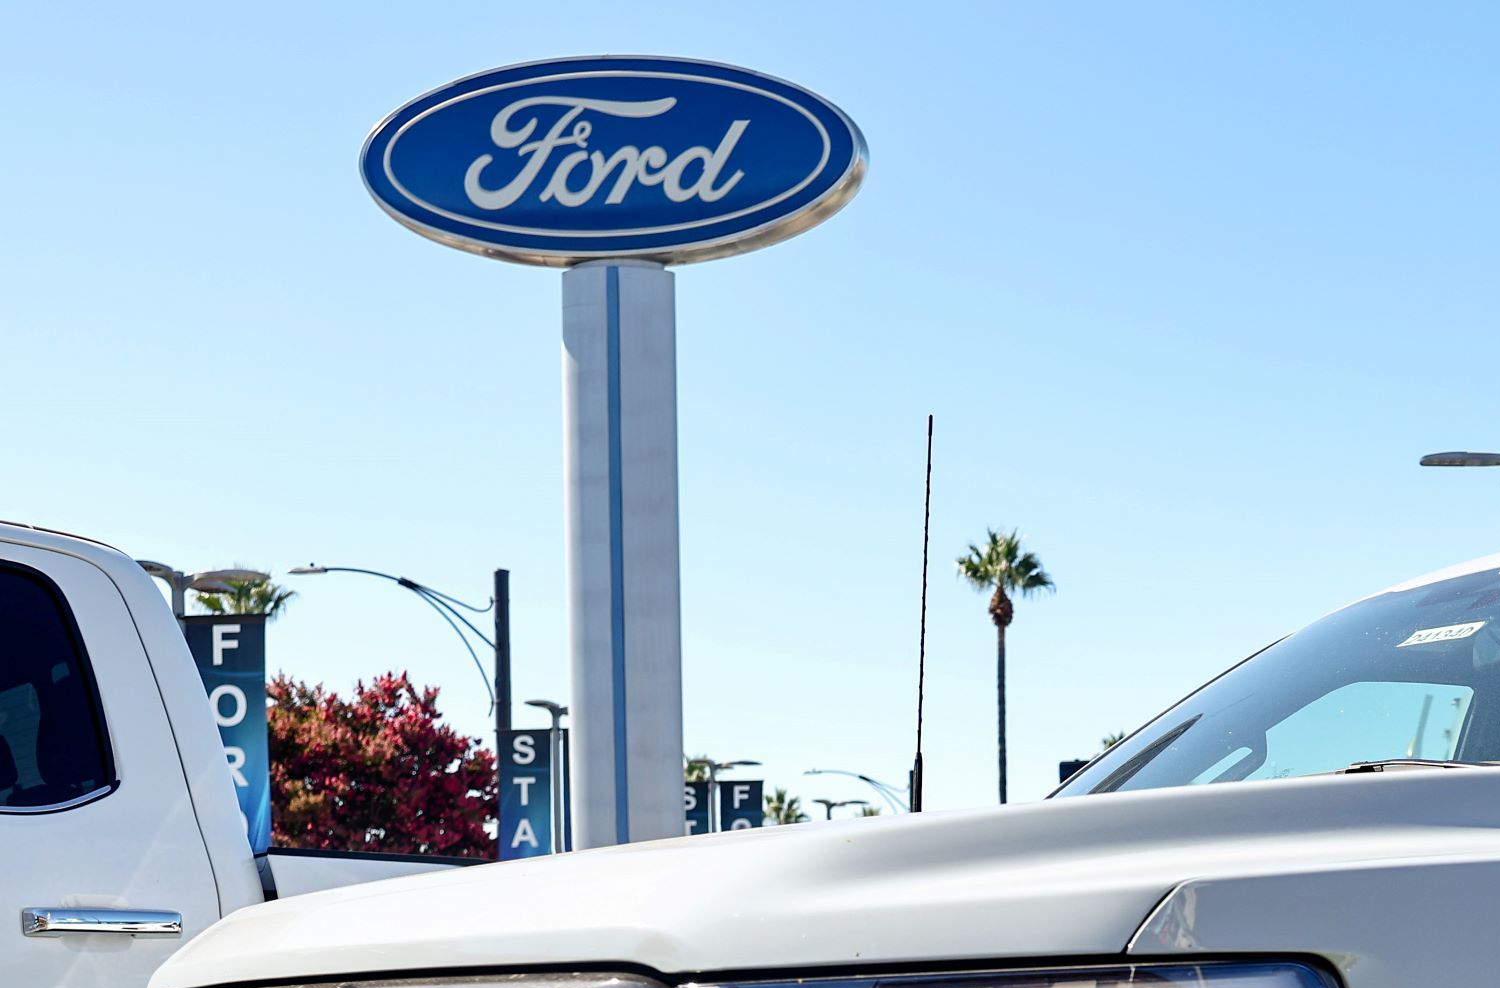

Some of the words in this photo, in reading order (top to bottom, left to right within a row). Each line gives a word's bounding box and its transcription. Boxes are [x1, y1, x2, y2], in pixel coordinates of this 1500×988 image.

[464, 96, 751, 210] Ford
[209, 623, 249, 836] FOR
[511, 734, 539, 848] STA
